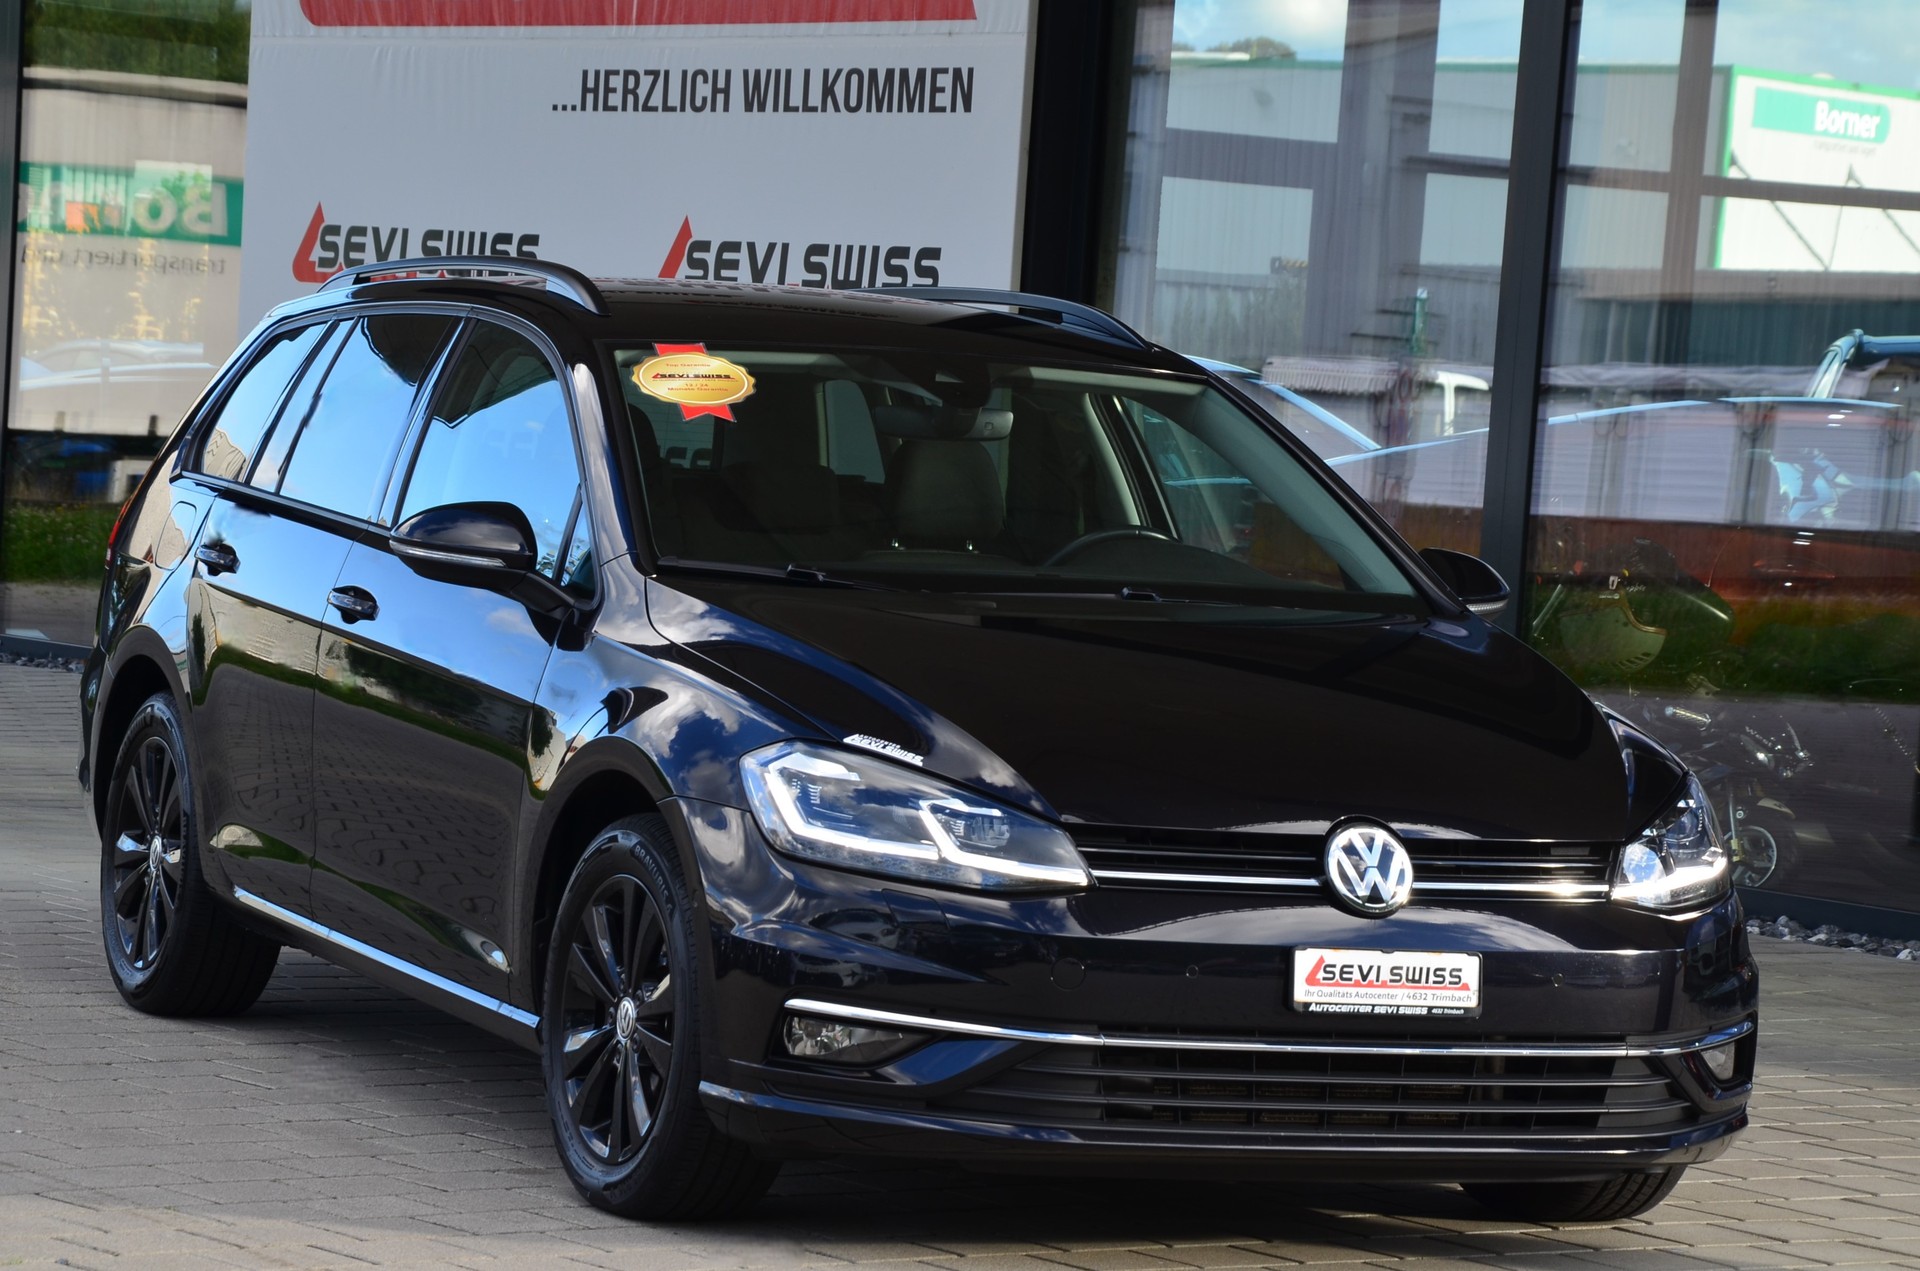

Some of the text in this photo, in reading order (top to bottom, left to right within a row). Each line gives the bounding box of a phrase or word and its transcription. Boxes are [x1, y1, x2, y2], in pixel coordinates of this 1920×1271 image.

[743, 67, 974, 113] WILLKOMMEN
[1814, 100, 1881, 138] Borner
[316, 224, 409, 269] SEVI
[685, 239, 942, 290] SEVI SWISS
[1321, 964, 1462, 985] SEVI SWISS
[1304, 990, 1316, 998] Ihr
[1354, 991, 1398, 1000] Autocenter
[1406, 992, 1428, 1001] 4632
[1431, 993, 1472, 1003] Trimbach
[1373, 1005, 1397, 1013] SEVI
[1398, 1006, 1428, 1014] SWISS
